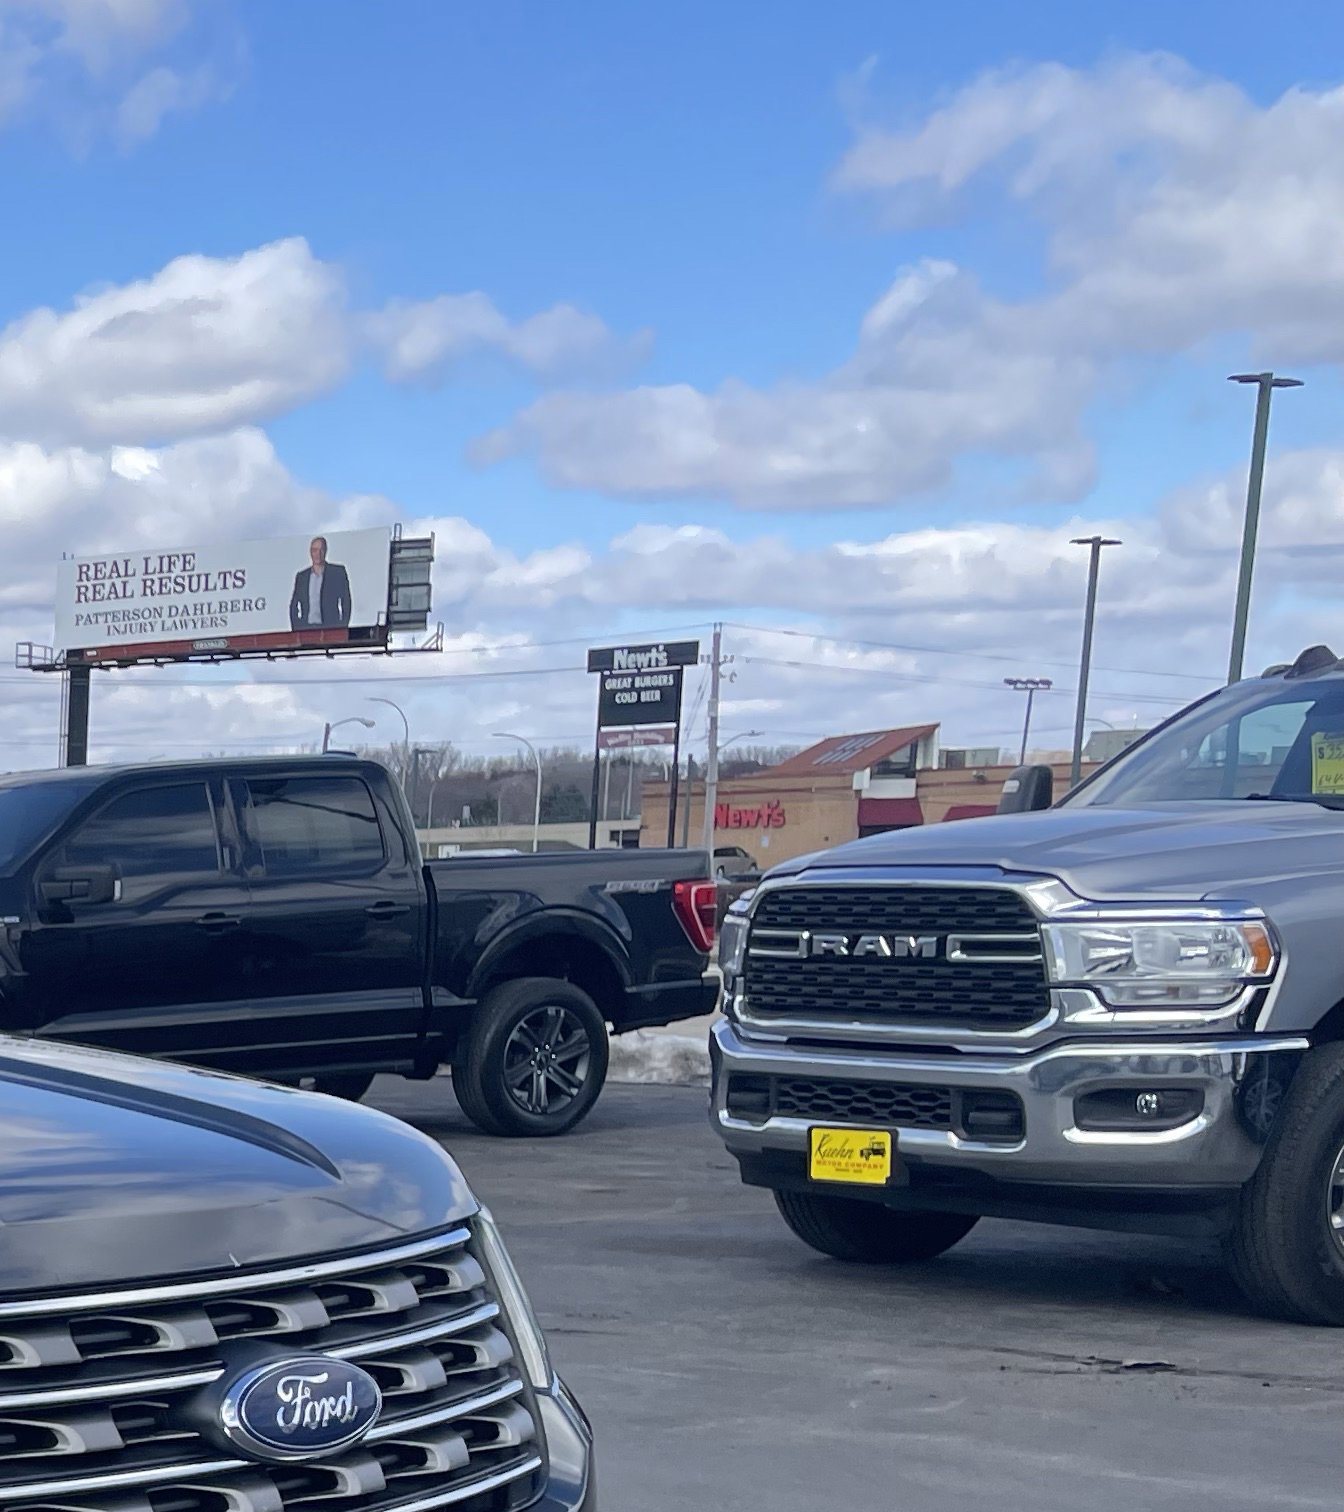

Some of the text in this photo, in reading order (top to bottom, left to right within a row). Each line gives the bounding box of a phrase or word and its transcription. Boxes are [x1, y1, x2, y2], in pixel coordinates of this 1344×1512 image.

[77, 552, 196, 582] REAL LIFE
[75, 568, 247, 604] REAL RESULTS
[74, 597, 267, 627] PATTERSON DAHLBERG
[106, 615, 229, 637] INJURY LAWYERS
[613, 644, 668, 670] Newt's
[604, 674, 674, 690] GREAT BURGERS
[615, 690, 661, 704] COLD BEER
[812, 934, 937, 958] RAM
[814, 1132, 854, 1160] Kuehn
[845, 1161, 884, 1170] COMPANY
[276, 1371, 359, 1435] Ford
